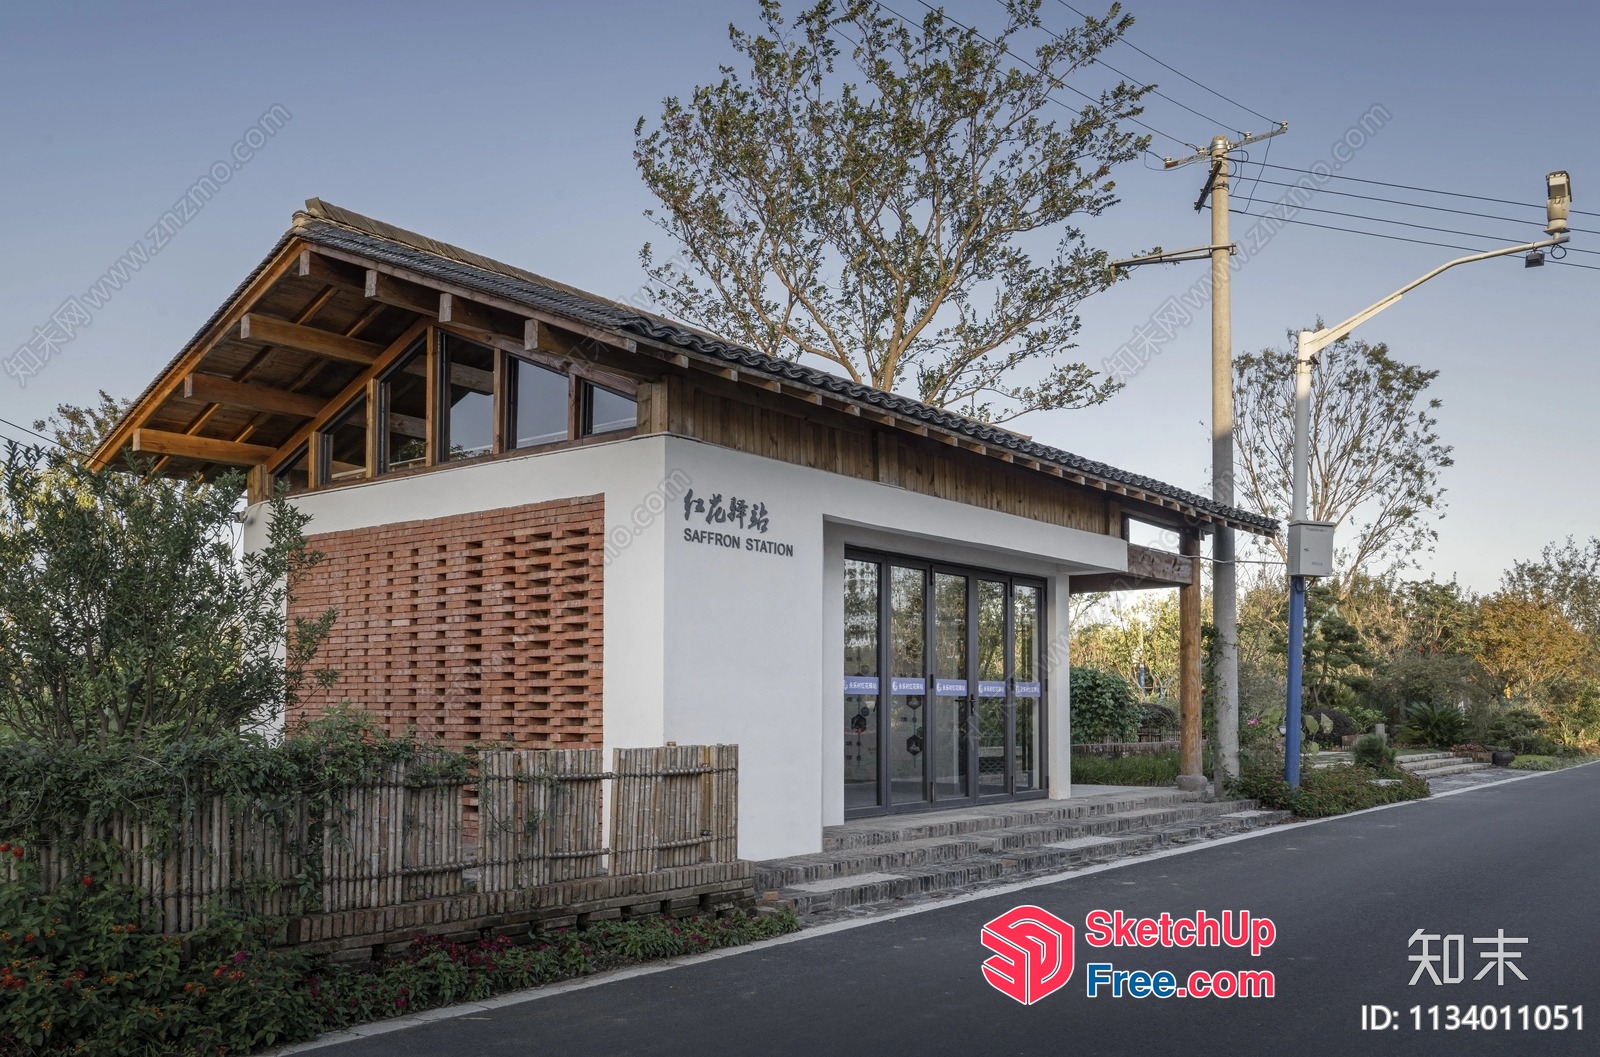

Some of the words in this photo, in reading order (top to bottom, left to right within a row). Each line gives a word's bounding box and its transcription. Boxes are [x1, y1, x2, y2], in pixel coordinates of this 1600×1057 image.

[684, 488, 769, 534] 红花驿站
[684, 528, 741, 549] SAFFRON
[745, 538, 793, 557] STATION
